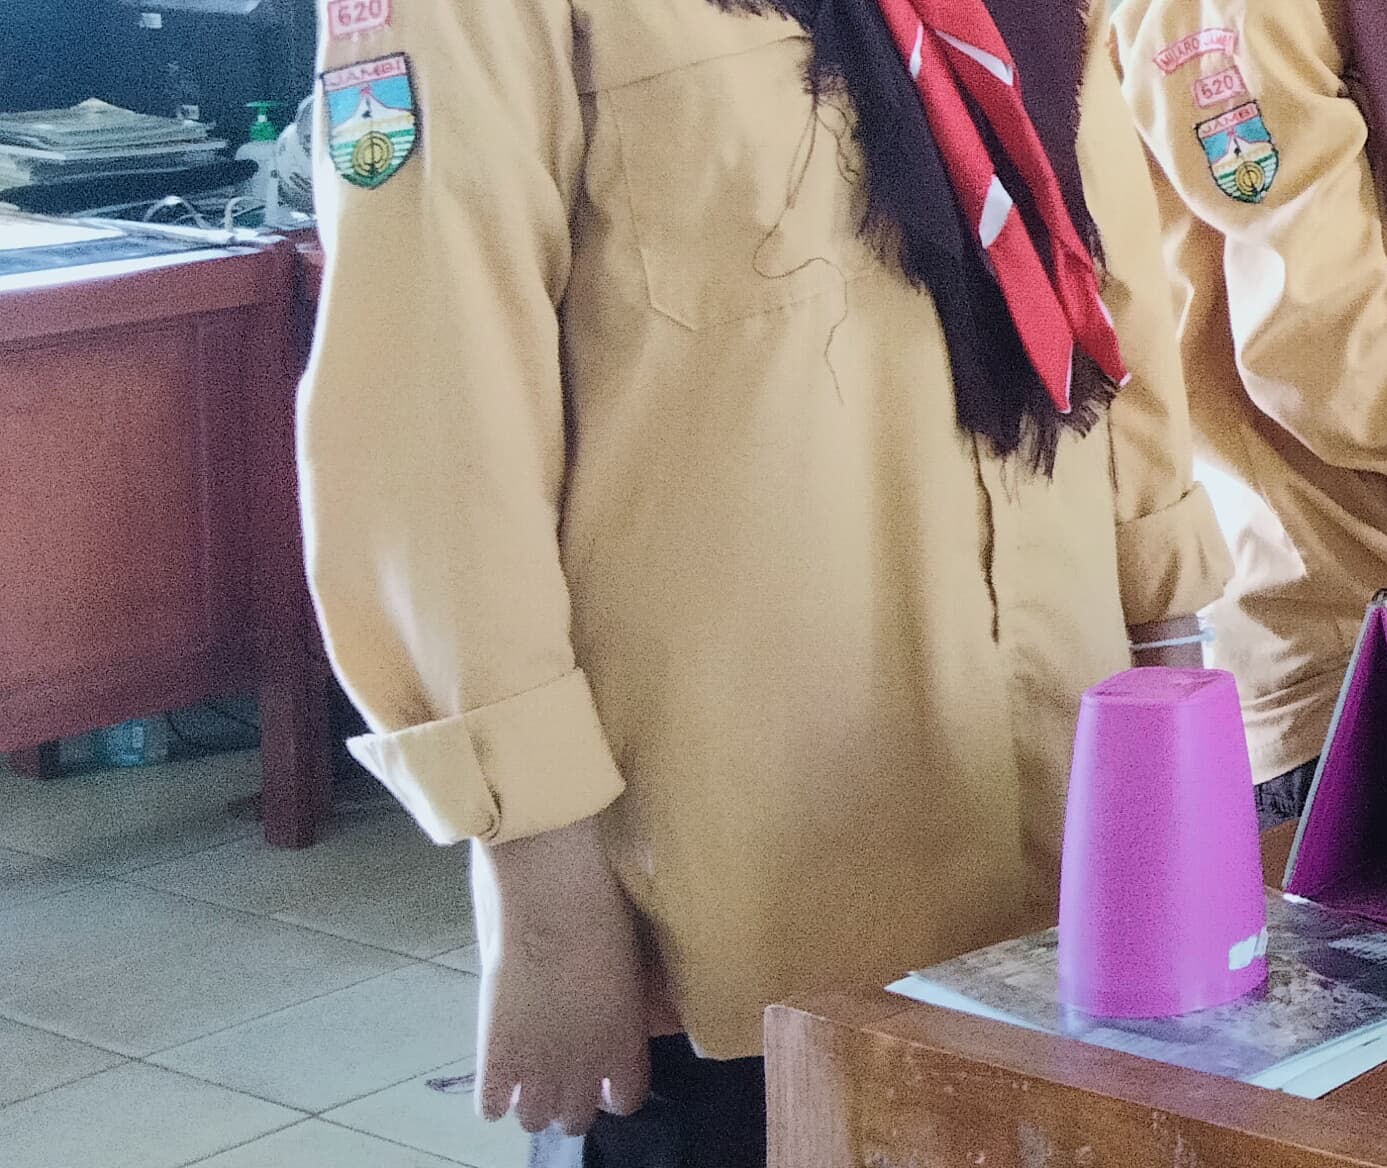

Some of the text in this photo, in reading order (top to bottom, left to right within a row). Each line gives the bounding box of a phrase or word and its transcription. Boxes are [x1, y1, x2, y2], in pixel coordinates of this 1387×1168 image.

[328, 60, 402, 88] JAMBI
[1202, 75, 1234, 98] 620
[1201, 107, 1258, 134] JAMBI
